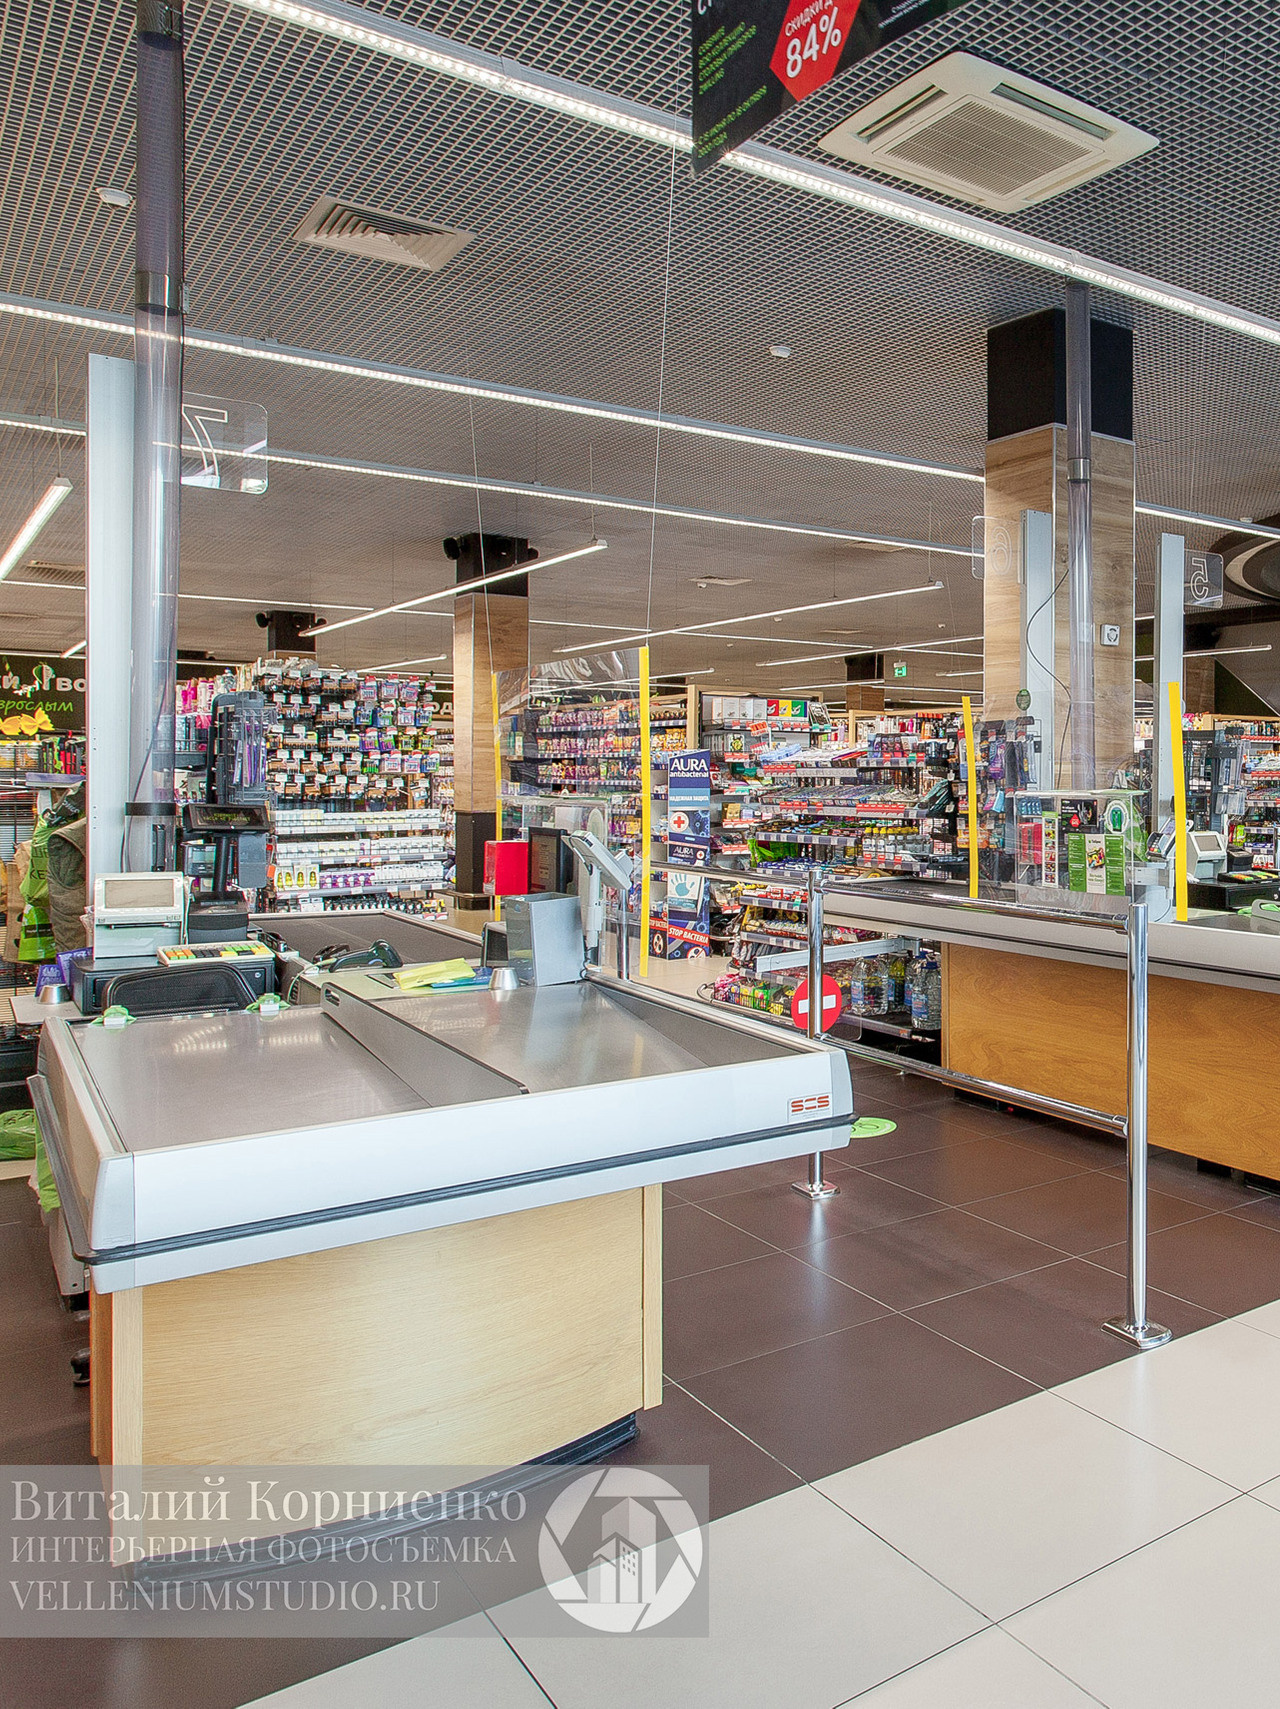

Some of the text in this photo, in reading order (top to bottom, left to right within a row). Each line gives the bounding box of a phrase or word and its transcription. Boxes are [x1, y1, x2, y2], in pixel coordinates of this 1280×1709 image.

[786, 6, 842, 78] 84%
[671, 758, 708, 771] AURA
[674, 846, 694, 855] AURA
[669, 927, 709, 944] STOP BACTERIA
[791, 1095, 829, 1112] SCS
